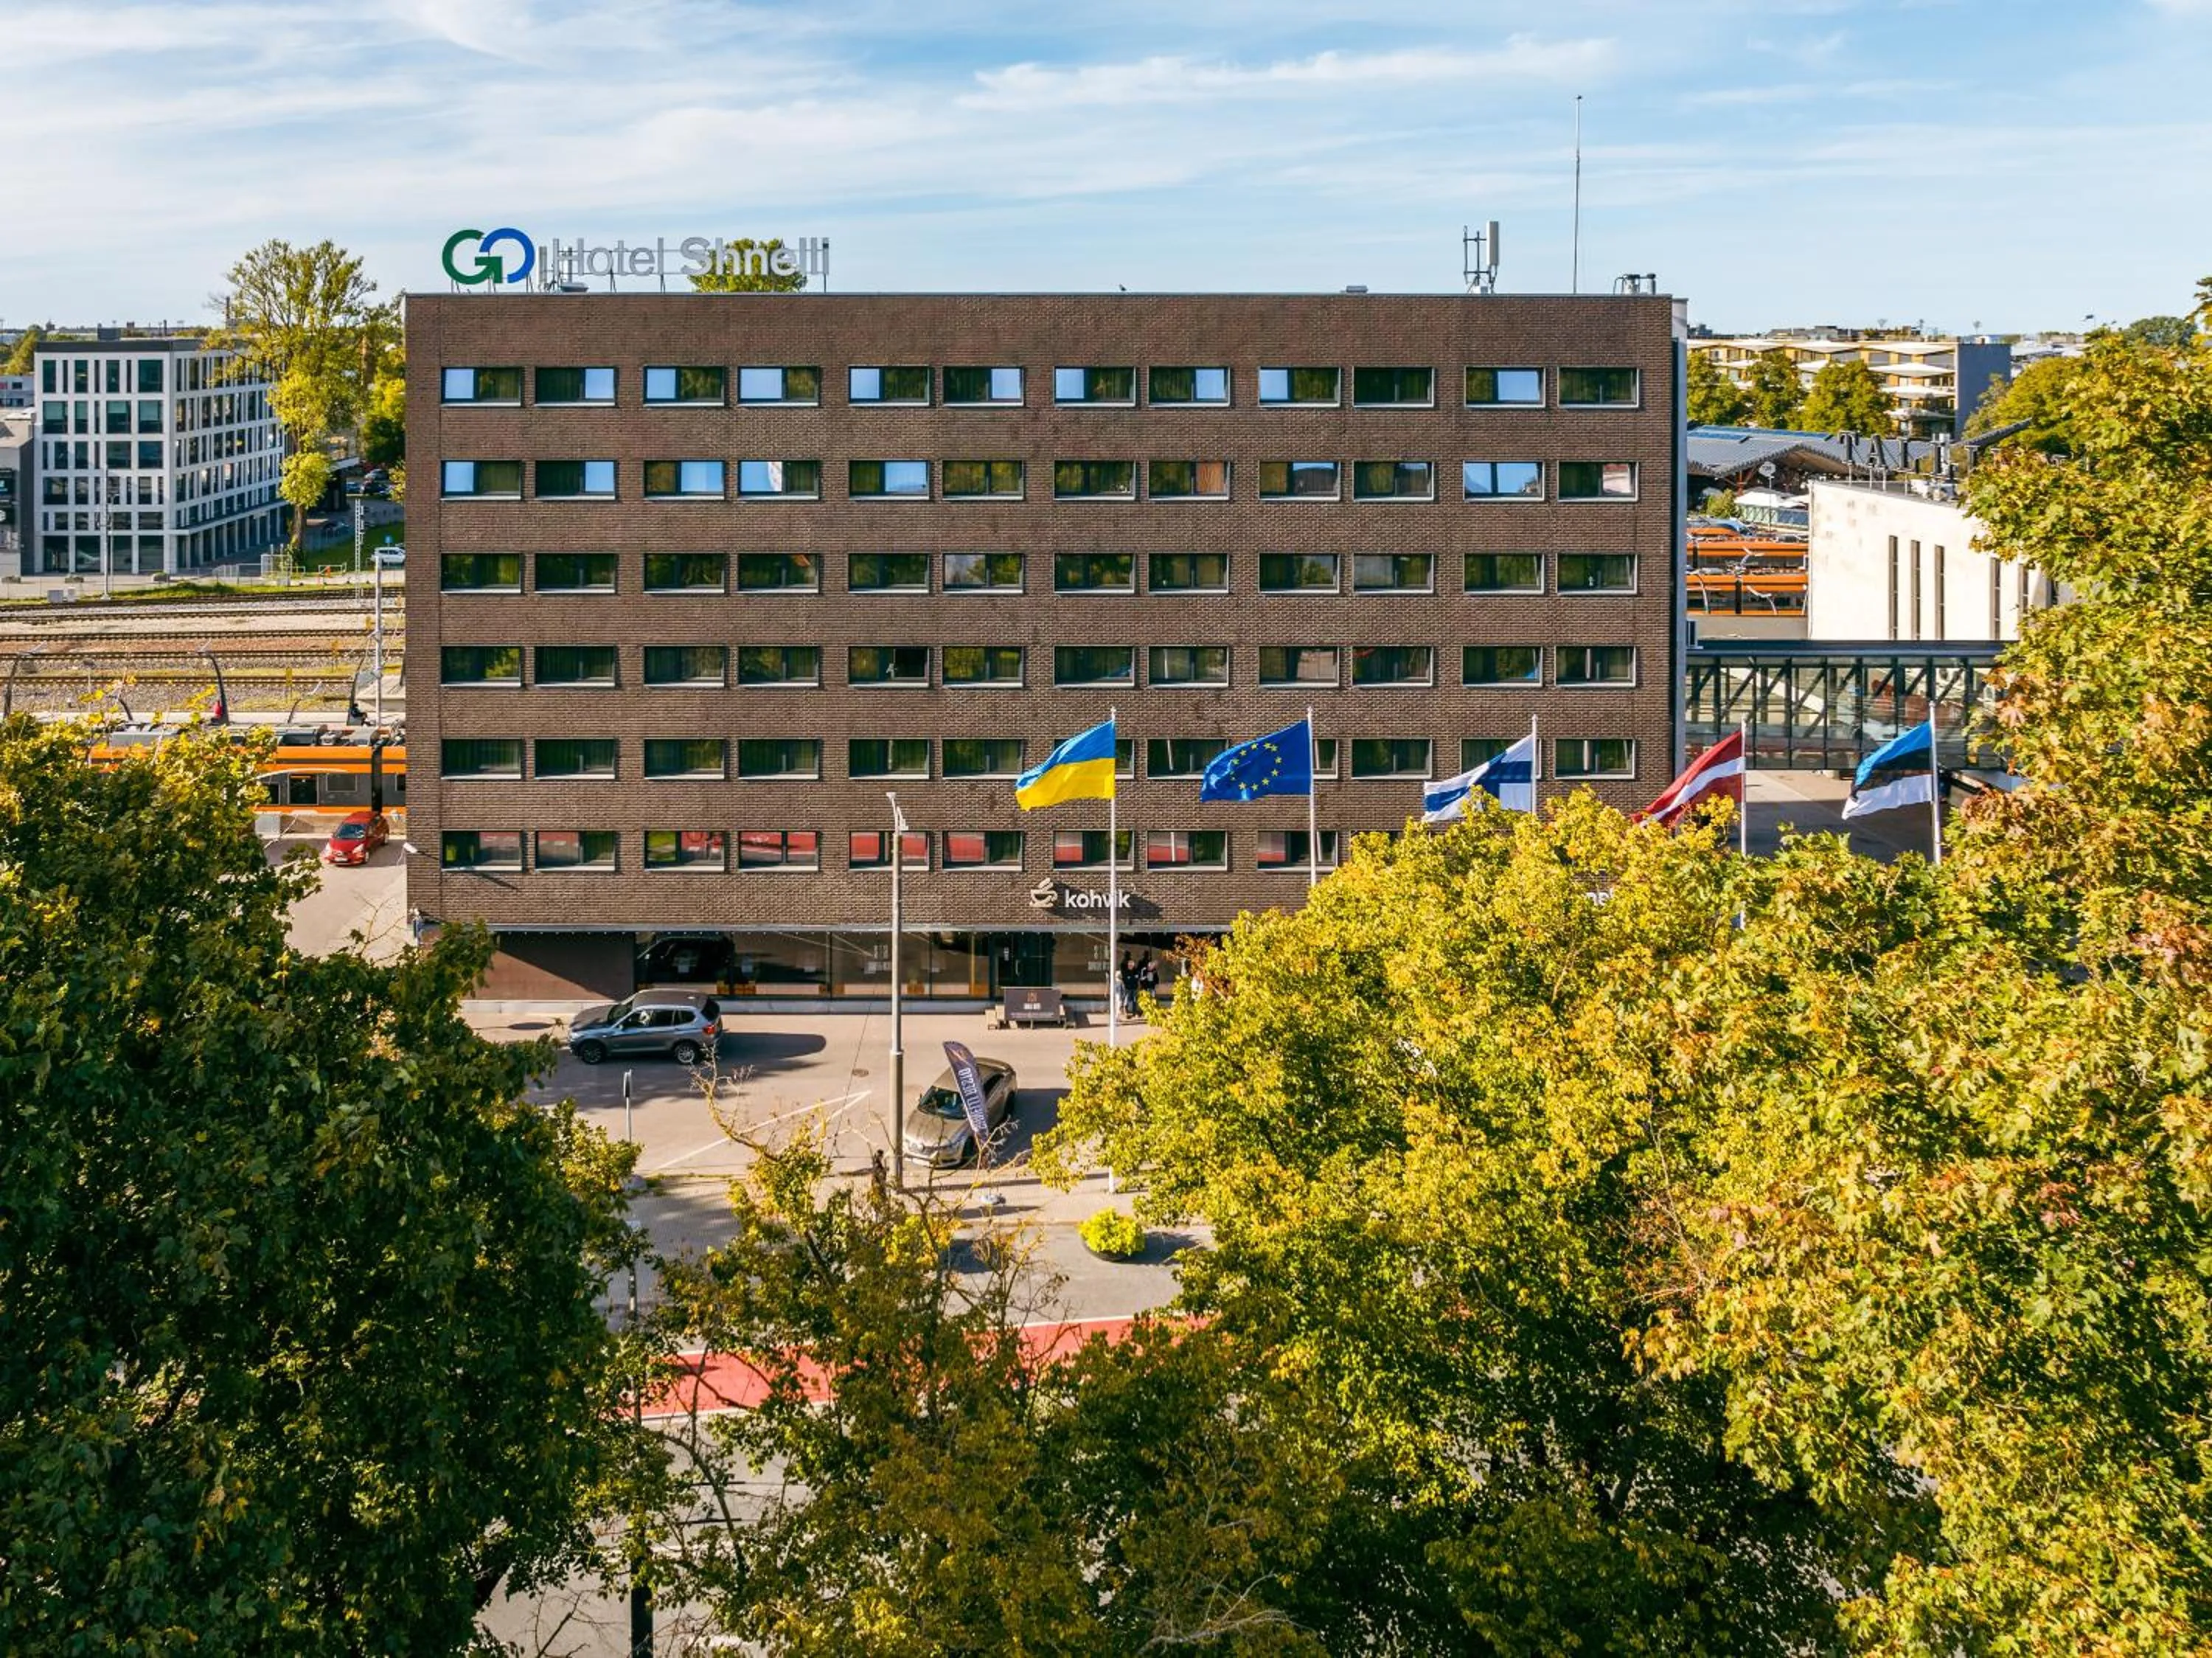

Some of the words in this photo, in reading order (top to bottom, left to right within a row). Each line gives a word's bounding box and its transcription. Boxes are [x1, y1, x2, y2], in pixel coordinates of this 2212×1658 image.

[442, 228, 535, 285] GO
[553, 237, 664, 277] Hotel
[679, 236, 830, 277] Shnelli
[1065, 889, 1131, 908] kohvik
